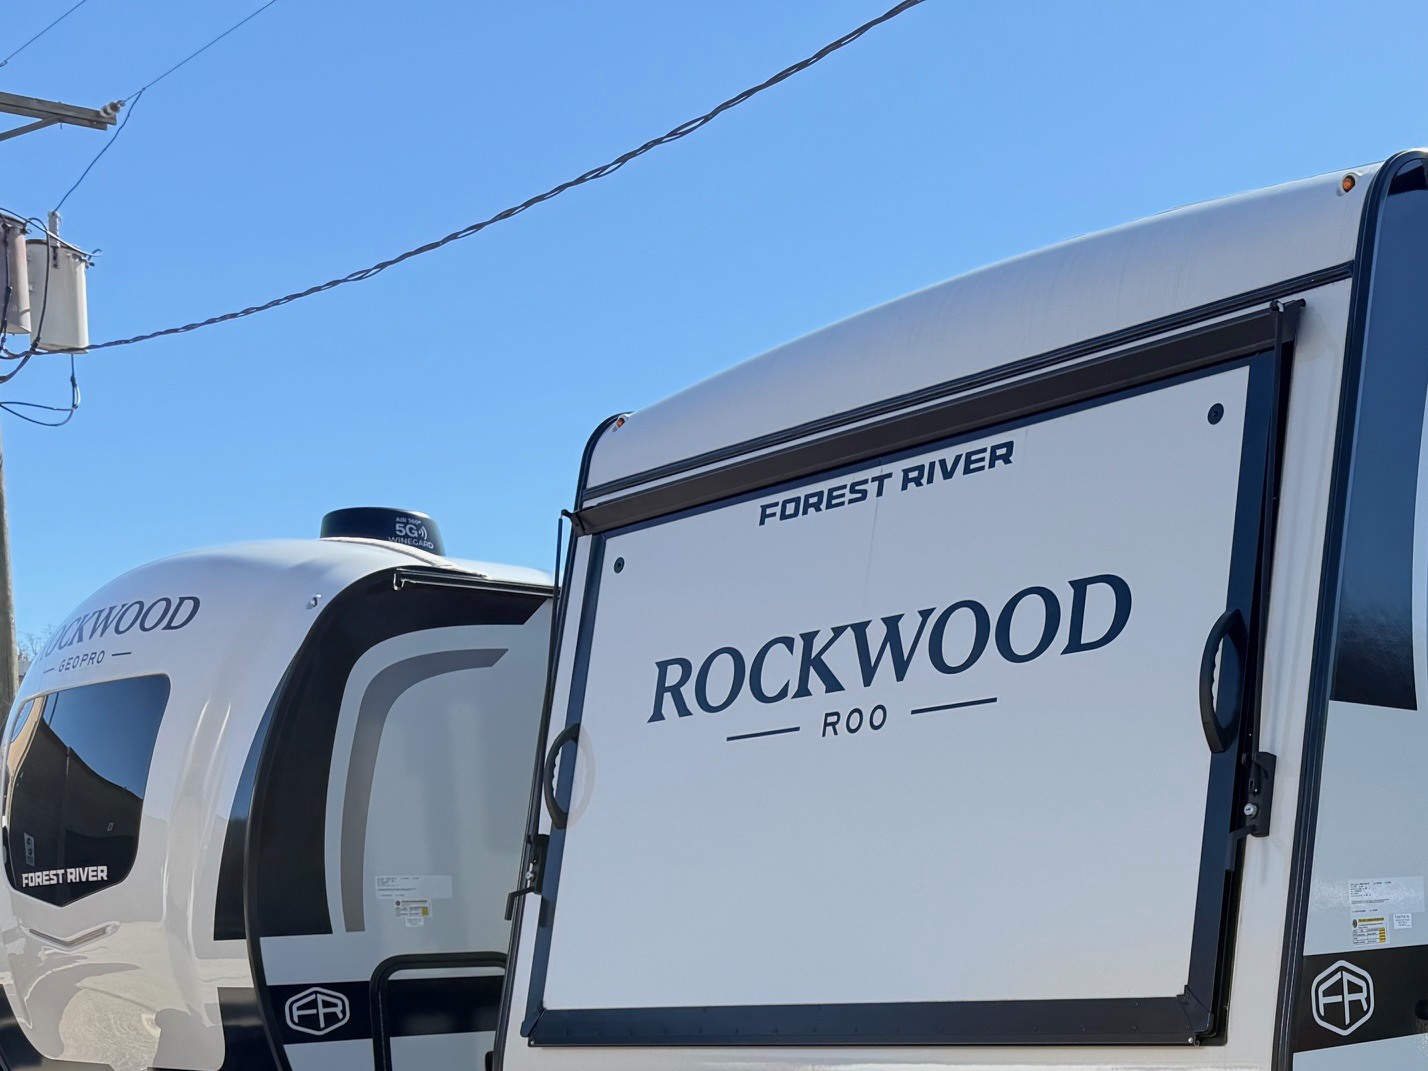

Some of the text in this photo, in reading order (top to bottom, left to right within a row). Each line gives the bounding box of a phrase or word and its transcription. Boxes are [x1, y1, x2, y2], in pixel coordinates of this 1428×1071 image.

[758, 440, 1014, 526] FOREST RIVER
[395, 523, 418, 537] 5G
[40, 596, 200, 661] OCKWOOD
[58, 650, 105, 672] GEOPRO
[647, 573, 1133, 723] ROCKWOOD
[821, 703, 887, 737] ROO
[22, 865, 108, 887] FOREST RIVER
